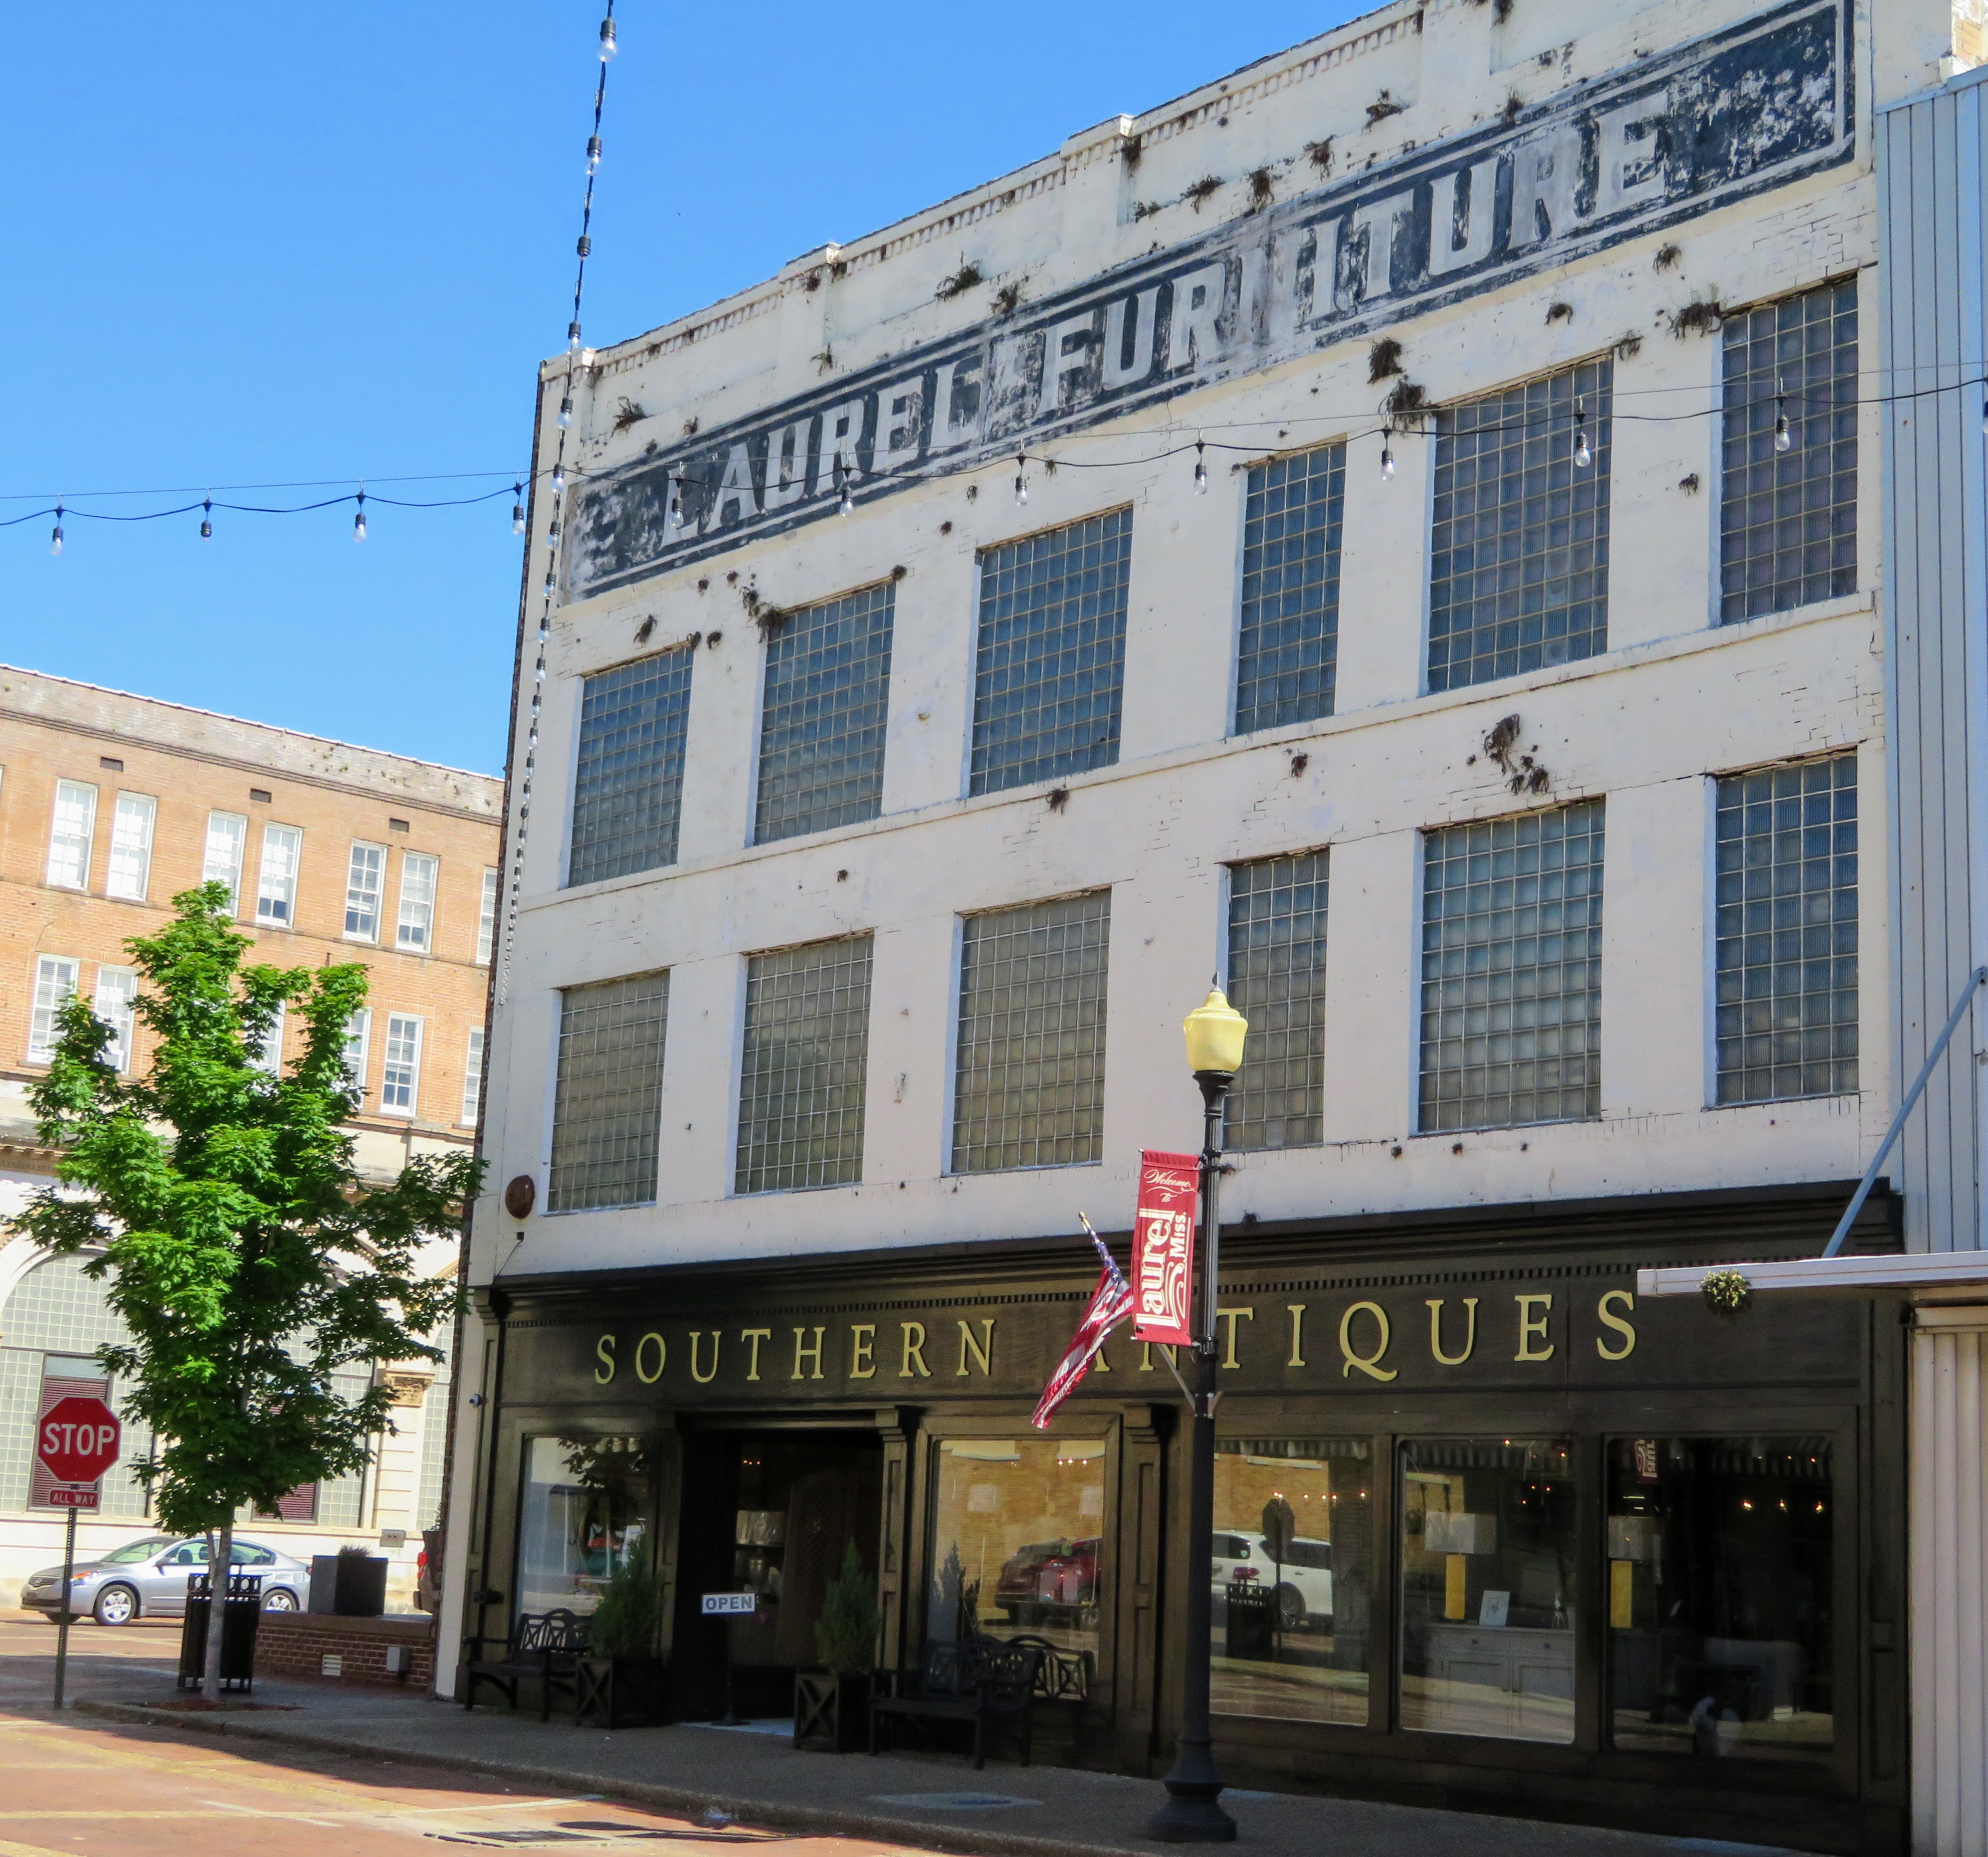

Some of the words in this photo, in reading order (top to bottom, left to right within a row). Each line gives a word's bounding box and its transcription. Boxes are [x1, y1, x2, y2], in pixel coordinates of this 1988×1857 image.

[660, 366, 985, 551] LAUREL
[1144, 1169, 1195, 1192] Welcome
[1160, 1193, 1178, 1203] to
[1136, 1208, 1184, 1330] Laurel
[594, 1318, 996, 1384] SOUTHERN
[1094, 1290, 1636, 1382] TIQUES
[43, 1423, 115, 1455] STOP
[52, 1492, 70, 1503] ALL
[75, 1494, 95, 1504] WAY
[705, 1596, 753, 1610] OPEN
